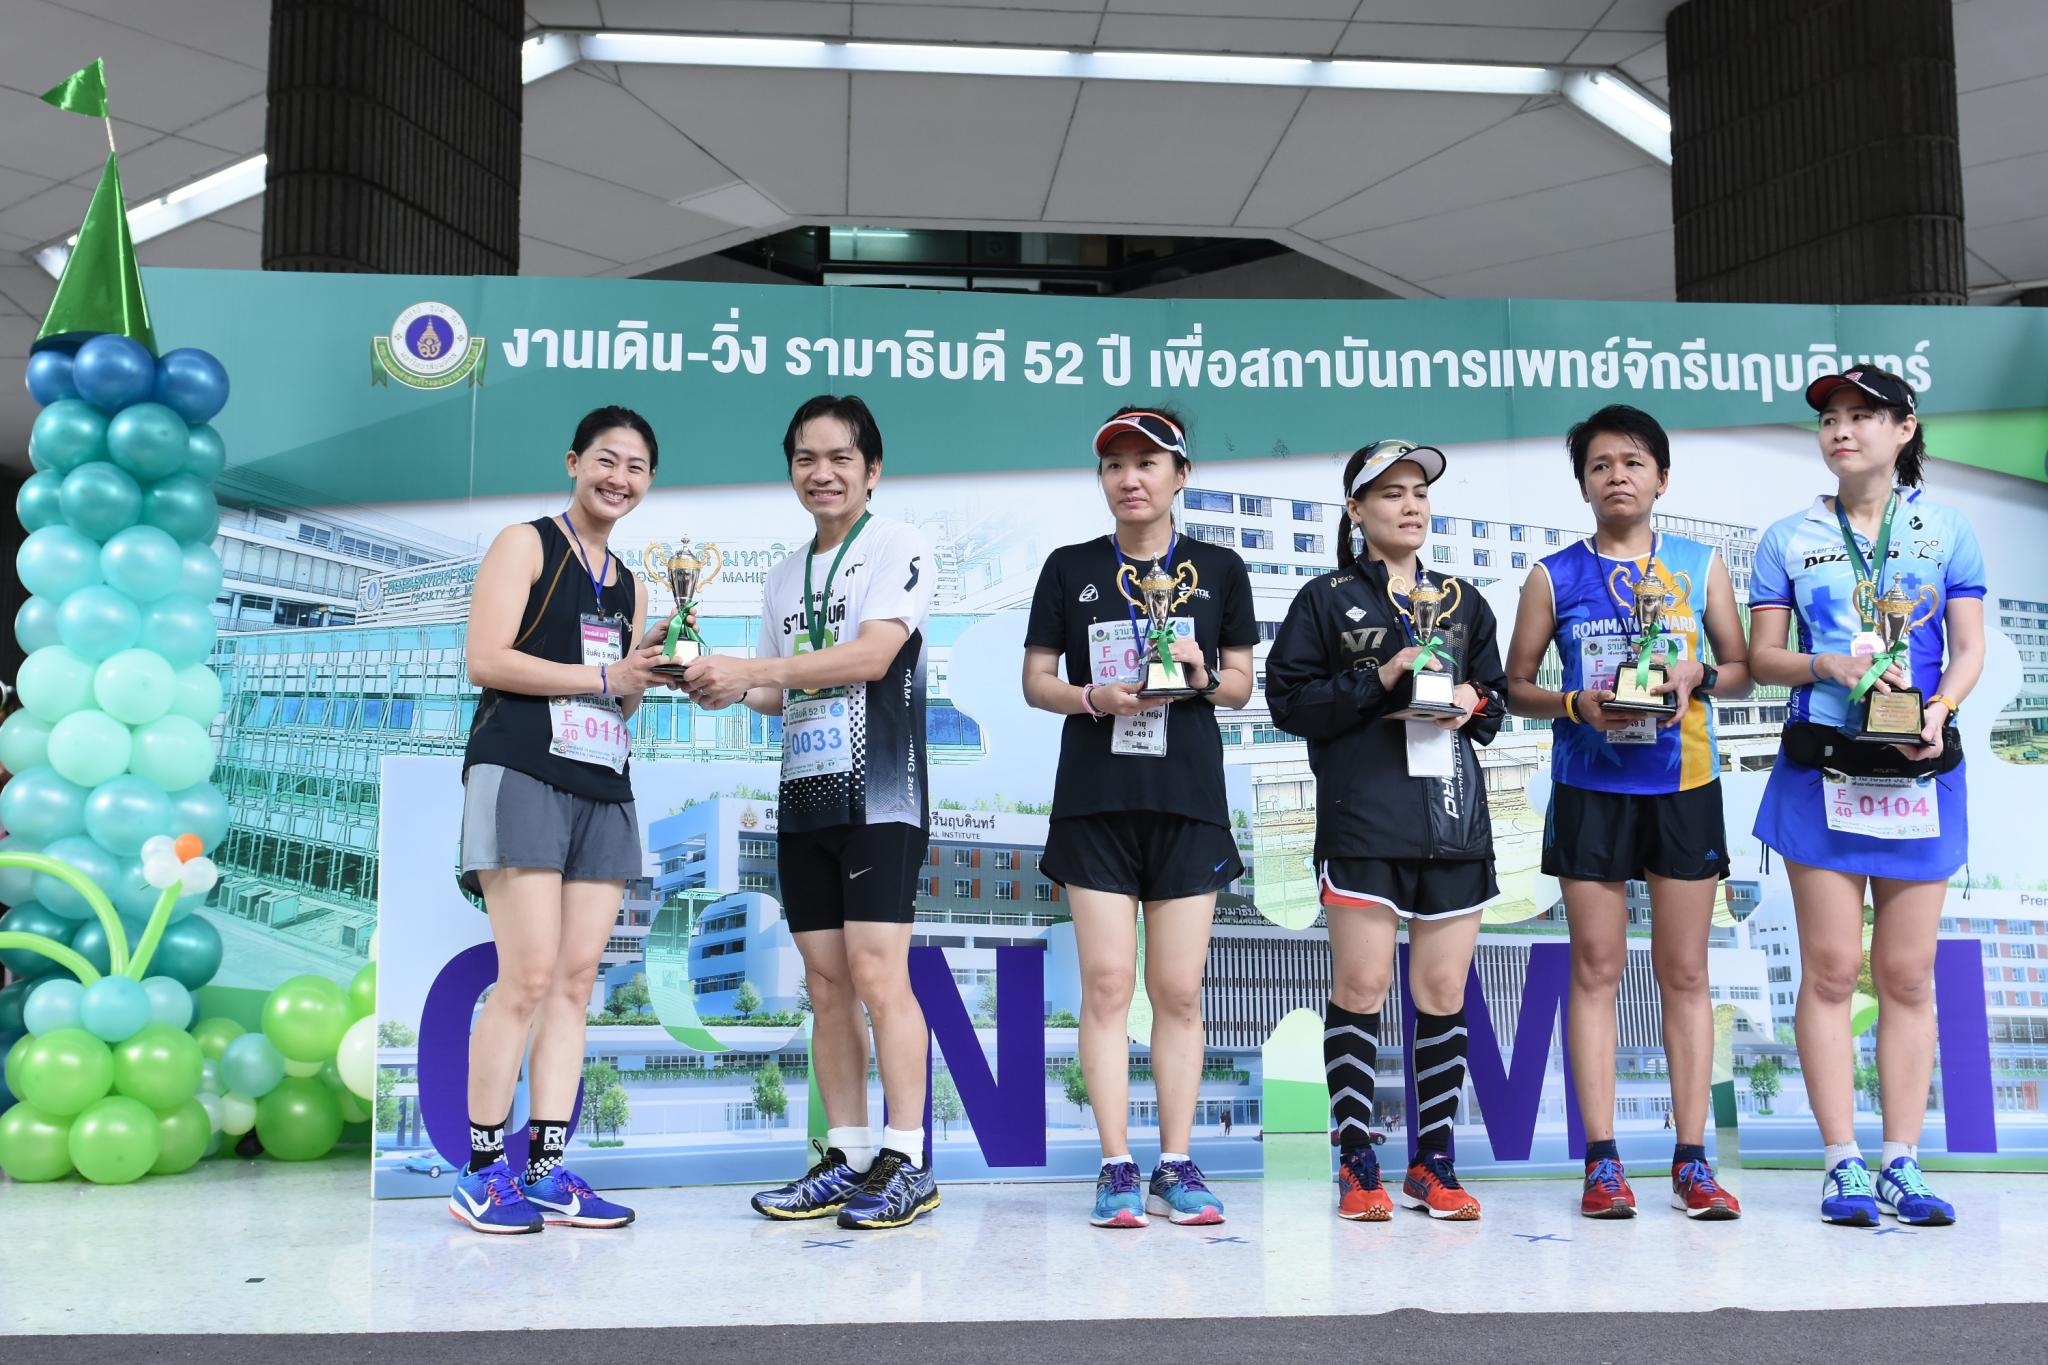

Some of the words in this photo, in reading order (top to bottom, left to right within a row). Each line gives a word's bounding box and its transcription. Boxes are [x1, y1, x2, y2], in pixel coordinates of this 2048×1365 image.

[502, 308, 766, 373] งานเดิน-วิ่ง
[787, 329, 1004, 381] รามาธิบดี
[1024, 341, 1082, 384] 52
[1098, 333, 1130, 385] ปี
[1803, 545, 1848, 556] exercis
[1103, 645, 1111, 658] F
[1100, 665, 1117, 678] 40
[1595, 660, 1604, 673] F
[564, 710, 573, 722] F
[808, 707, 818, 716] 52
[820, 705, 826, 715] ปี
[562, 728, 578, 741] 40
[584, 717, 629, 749] 0111
[1125, 730, 1147, 738] 40-49
[792, 727, 842, 755] 0033
[1838, 788, 1847, 800] F
[1835, 806, 1853, 818] 40
[1859, 796, 1930, 817] 0104
[942, 831, 981, 840] INSTITUTE
